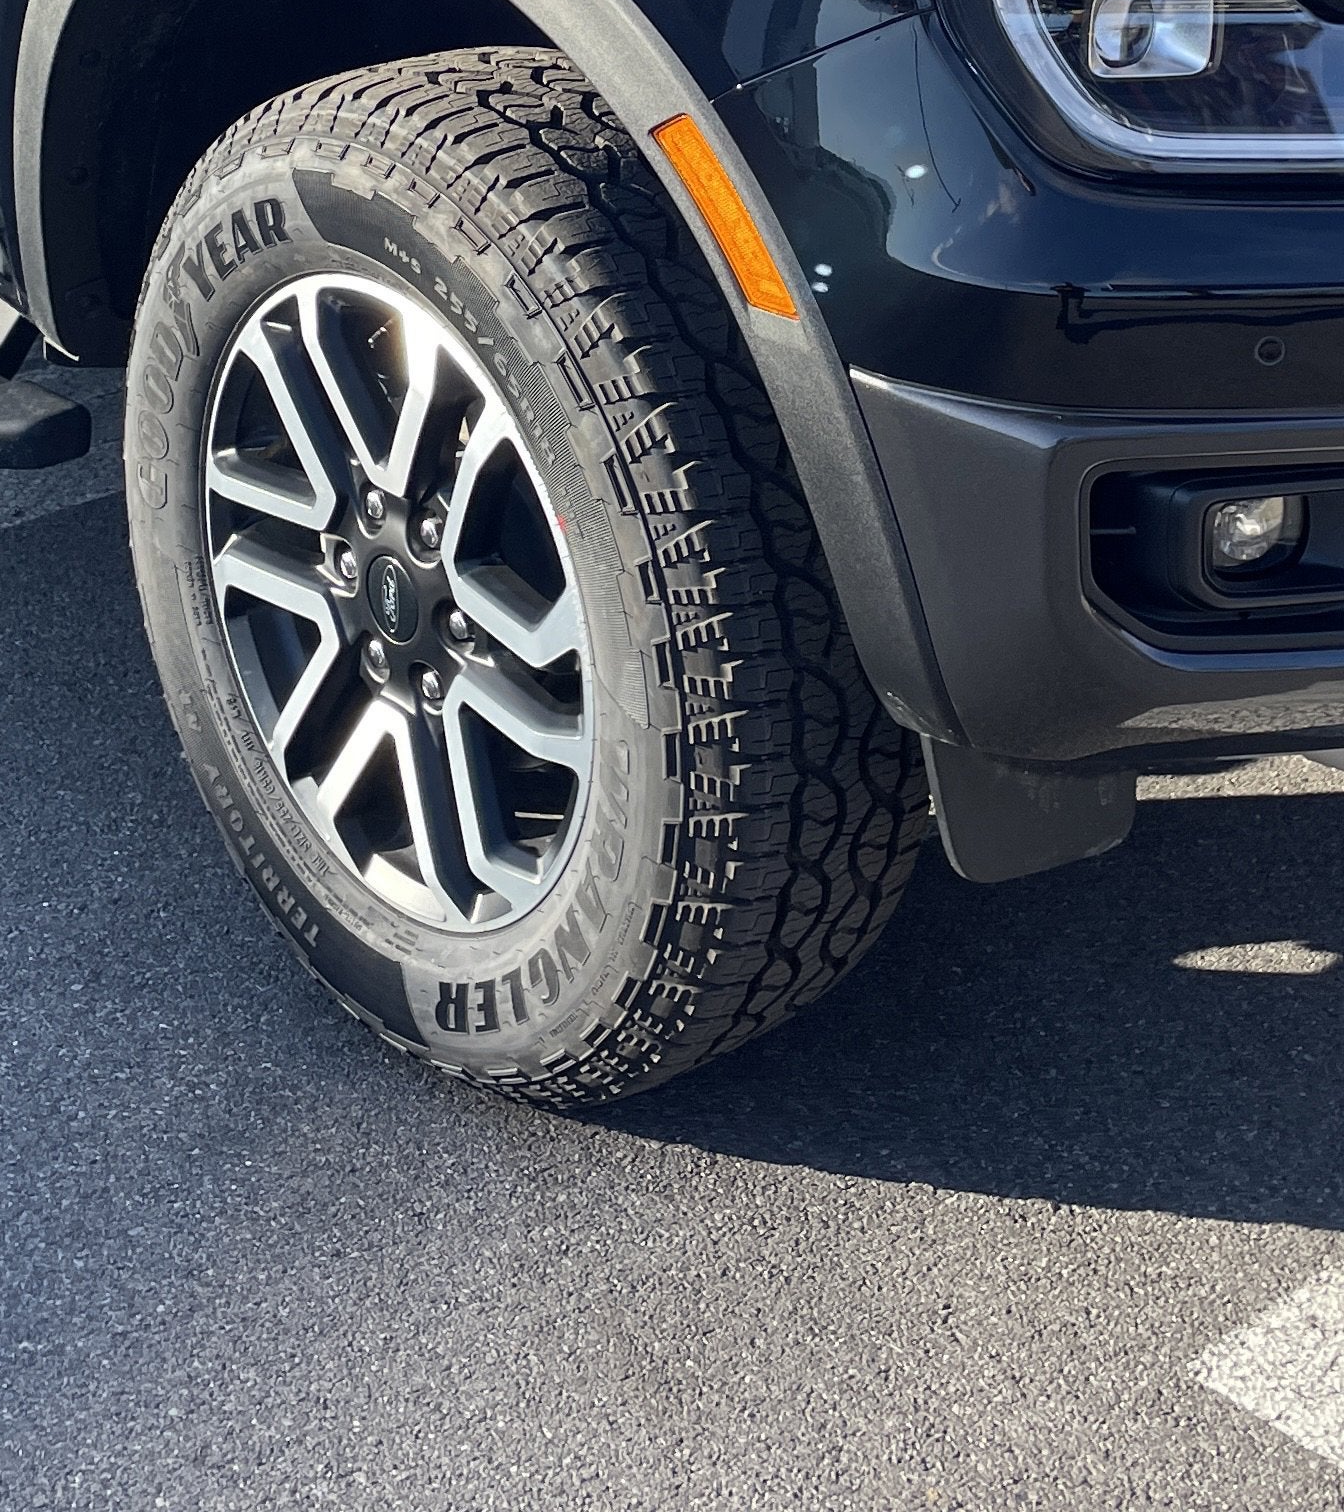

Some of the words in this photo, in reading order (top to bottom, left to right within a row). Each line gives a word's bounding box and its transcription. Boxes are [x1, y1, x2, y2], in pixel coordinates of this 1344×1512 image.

[138, 197, 294, 509] GOODYEAR
[384, 238, 422, 275] M+S
[203, 763, 320, 949] TERRITORY
[435, 740, 631, 1035] WRANGLER
